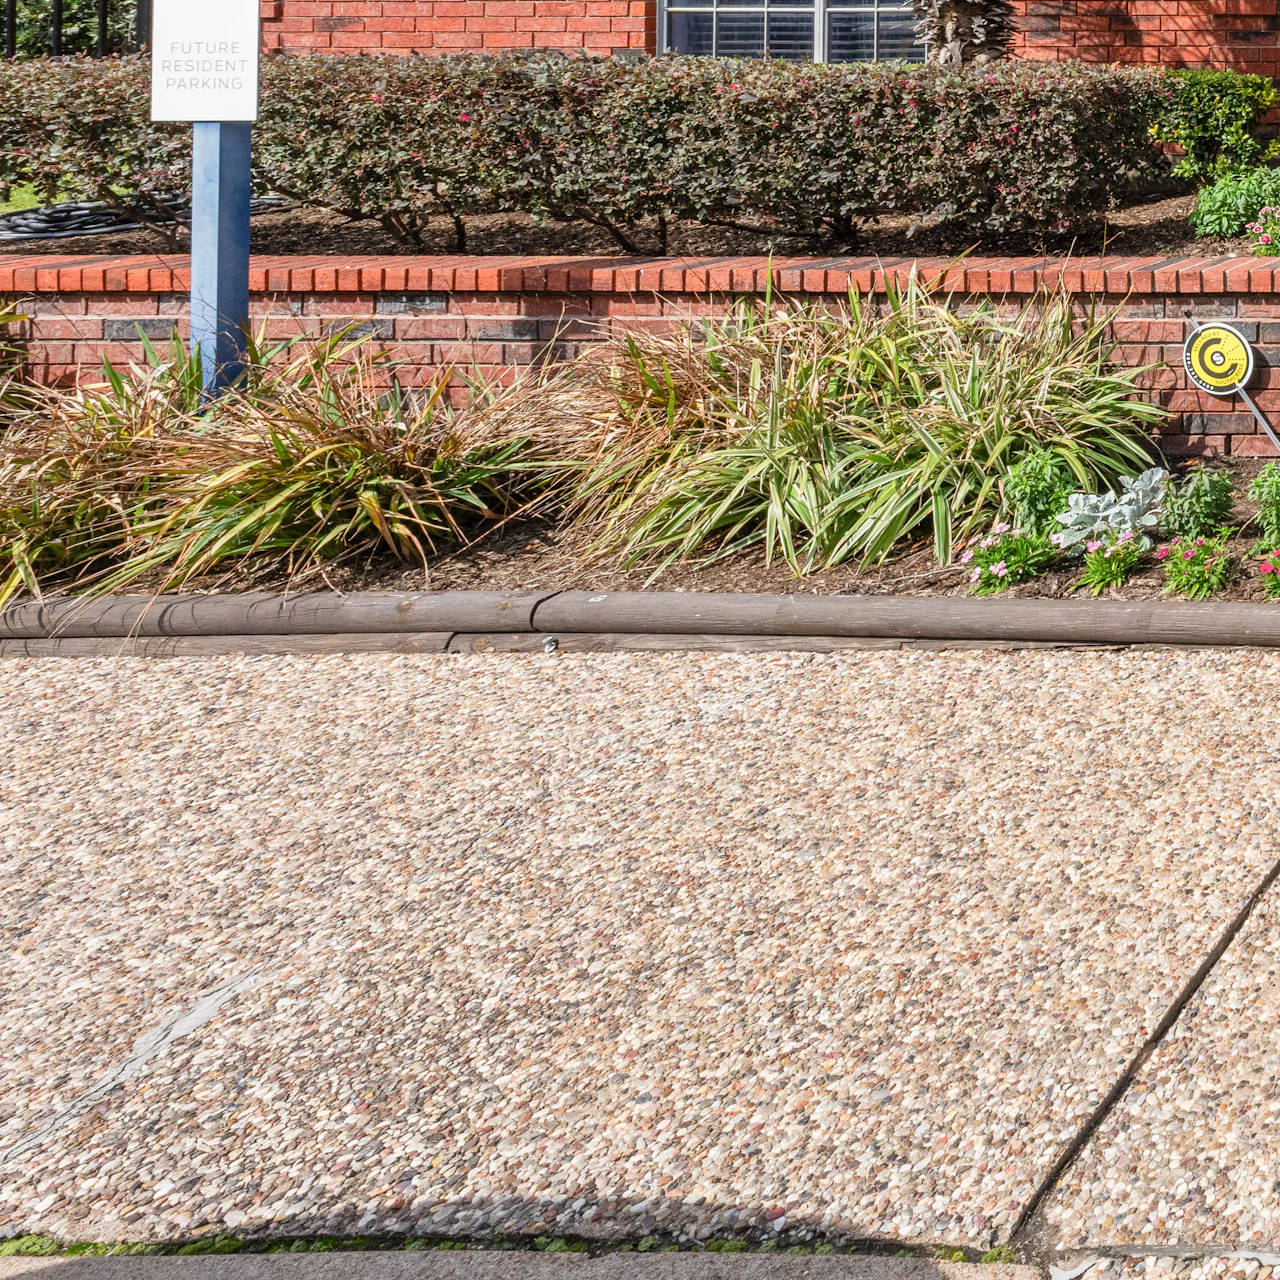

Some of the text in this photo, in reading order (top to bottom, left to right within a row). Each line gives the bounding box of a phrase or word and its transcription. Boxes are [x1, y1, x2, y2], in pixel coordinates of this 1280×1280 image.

[170, 41, 241, 55] FUTURE
[161, 59, 248, 72] RESIDENT
[166, 77, 243, 90] PARKING
[1193, 333, 1212, 352] SECURED
[1215, 363, 1244, 385] SOUTHCROSS
